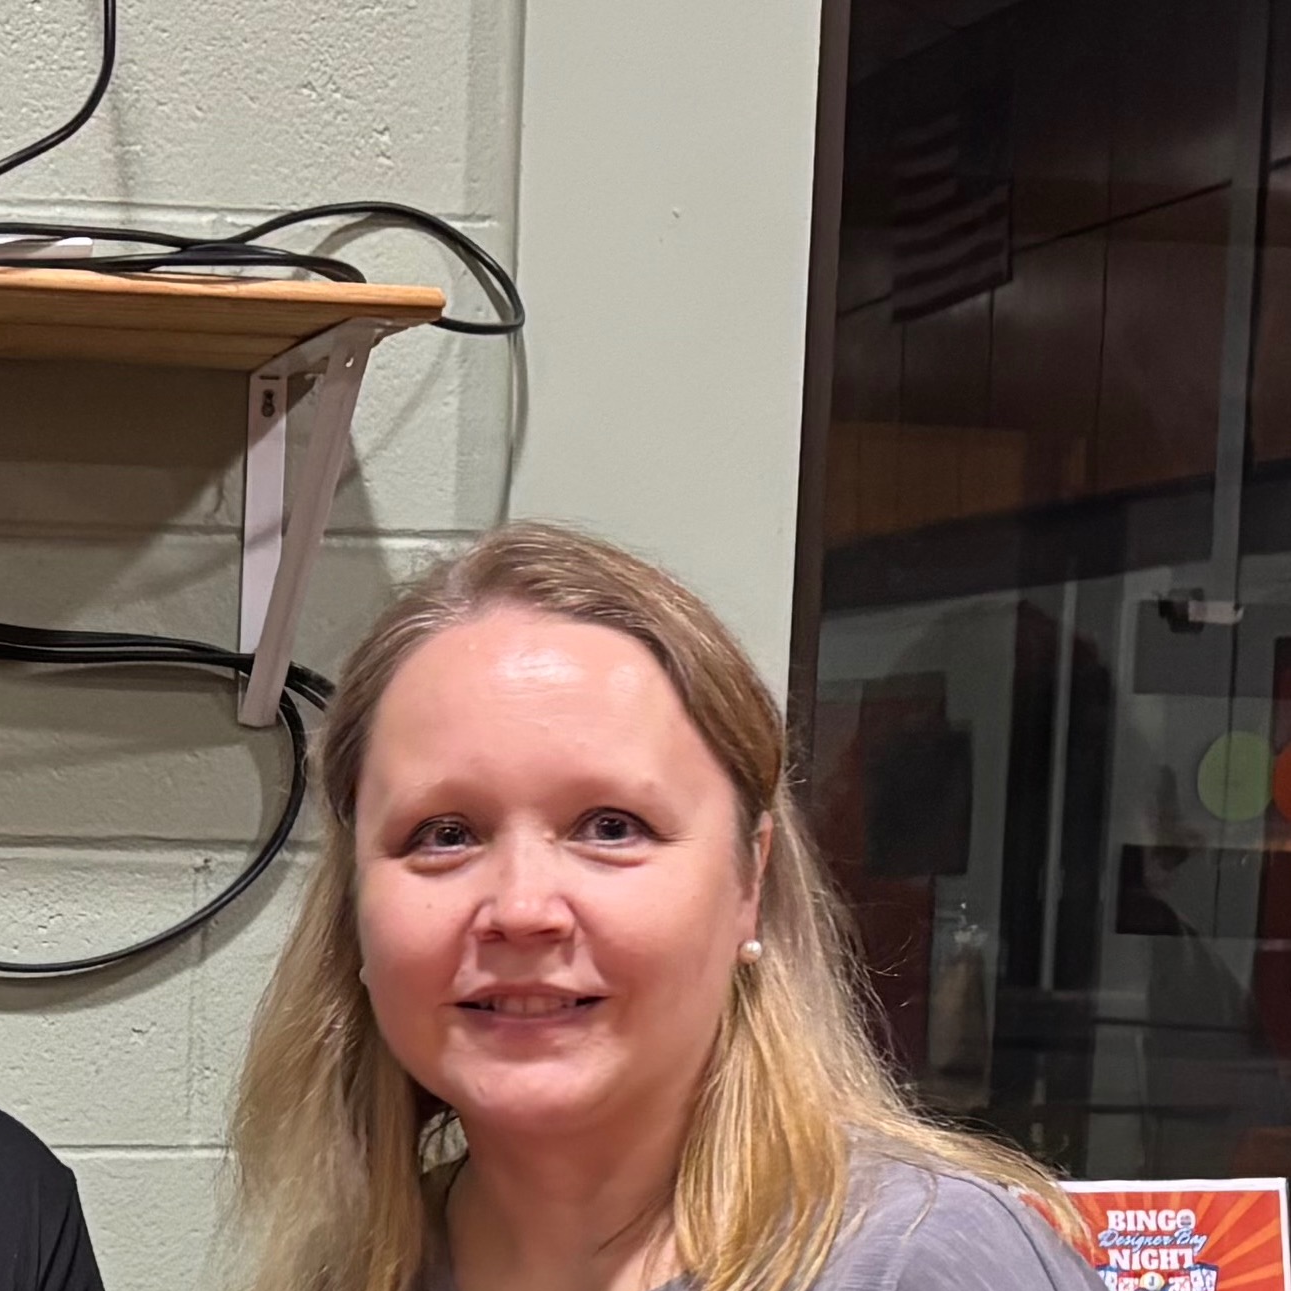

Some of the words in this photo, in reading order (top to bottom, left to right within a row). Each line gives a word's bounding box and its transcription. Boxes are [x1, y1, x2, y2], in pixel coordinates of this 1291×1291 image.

[1106, 1209, 1196, 1231] BINGO
[1098, 1229, 1172, 1252] Designer
[1174, 1228, 1207, 1254] Bag
[1107, 1248, 1195, 1271] NIGHT
